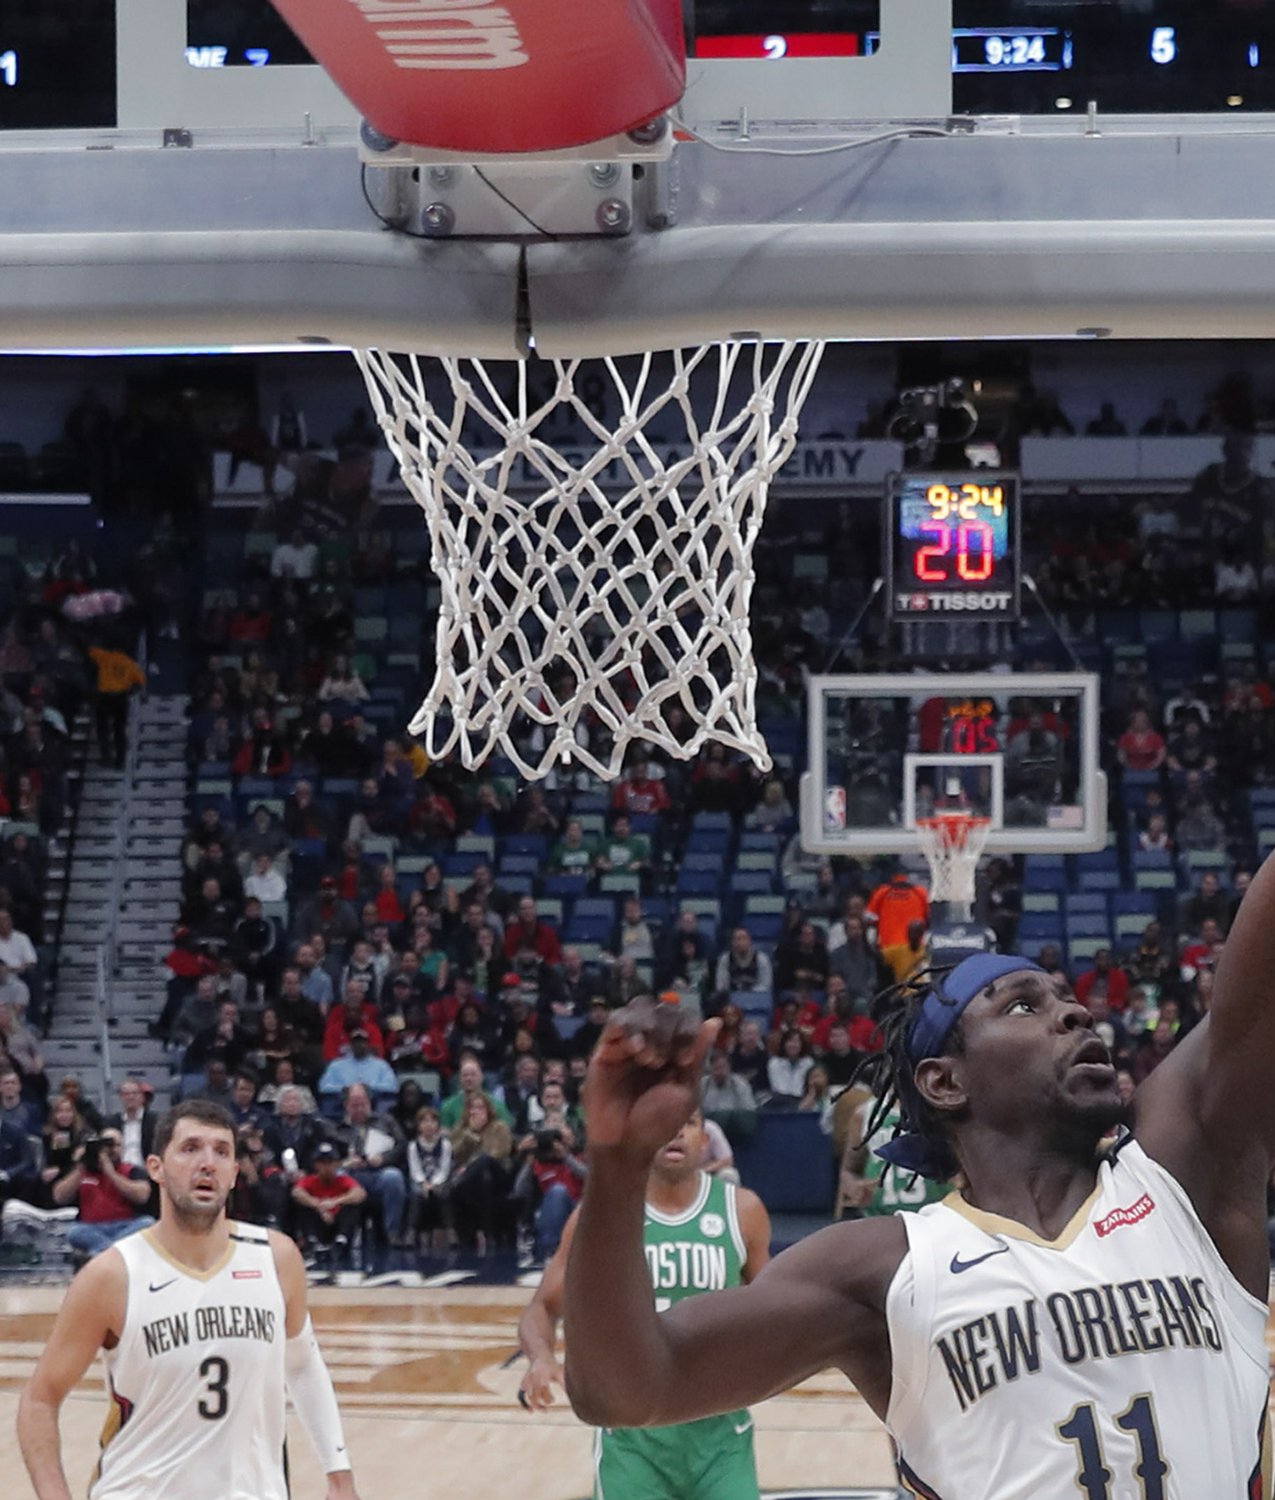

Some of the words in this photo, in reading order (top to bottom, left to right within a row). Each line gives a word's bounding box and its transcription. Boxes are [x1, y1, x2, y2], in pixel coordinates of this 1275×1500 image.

[984, 36, 1044, 65] 9:24
[1151, 26, 1176, 64] 5
[927, 484, 1003, 520] 9:24
[914, 521, 993, 581] 20
[928, 592, 1012, 611] TISSOT
[644, 1242, 727, 1291] OSTON
[142, 1311, 190, 1359] NEW
[195, 1305, 276, 1344] ORLEANS
[937, 1298, 1041, 1413] NEW
[1047, 1275, 1223, 1365] ORLEANS
[198, 1355, 230, 1421] 3
